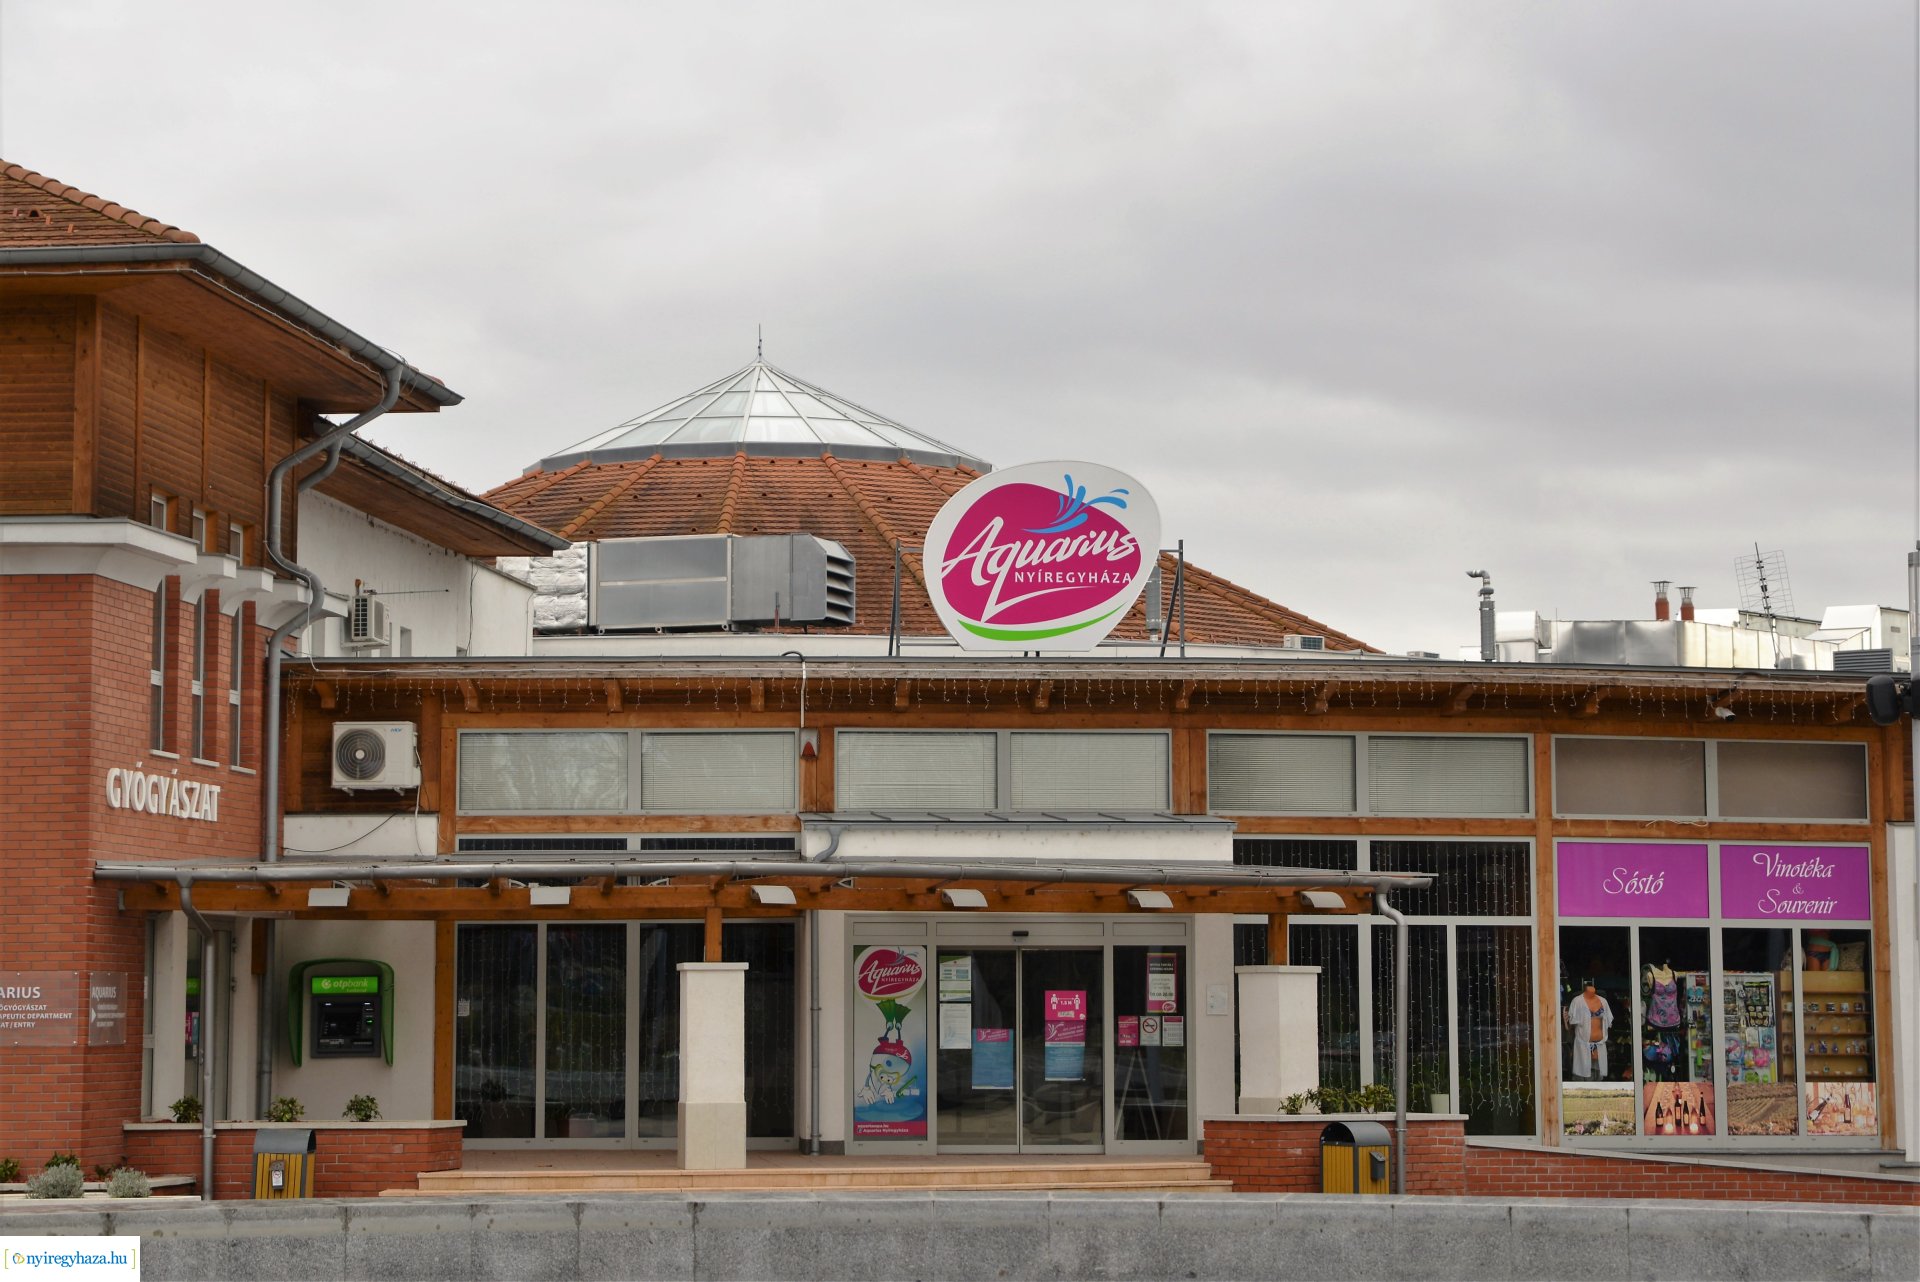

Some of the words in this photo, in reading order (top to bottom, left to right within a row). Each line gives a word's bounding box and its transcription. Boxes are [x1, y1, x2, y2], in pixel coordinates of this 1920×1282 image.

[940, 516, 1138, 623] Aquarius
[1014, 569, 1132, 584] NYÍREGYHÁZA
[106, 761, 221, 822] GYÓGYÁSZAT
[1753, 852, 1836, 878] Vinotéka
[1602, 867, 1665, 895] Sóstó
[1792, 882, 1805, 895] &
[1757, 888, 1838, 915] Souvenir
[858, 960, 921, 995] Aquarius
[91, 986, 117, 1002] AQUARIUS
